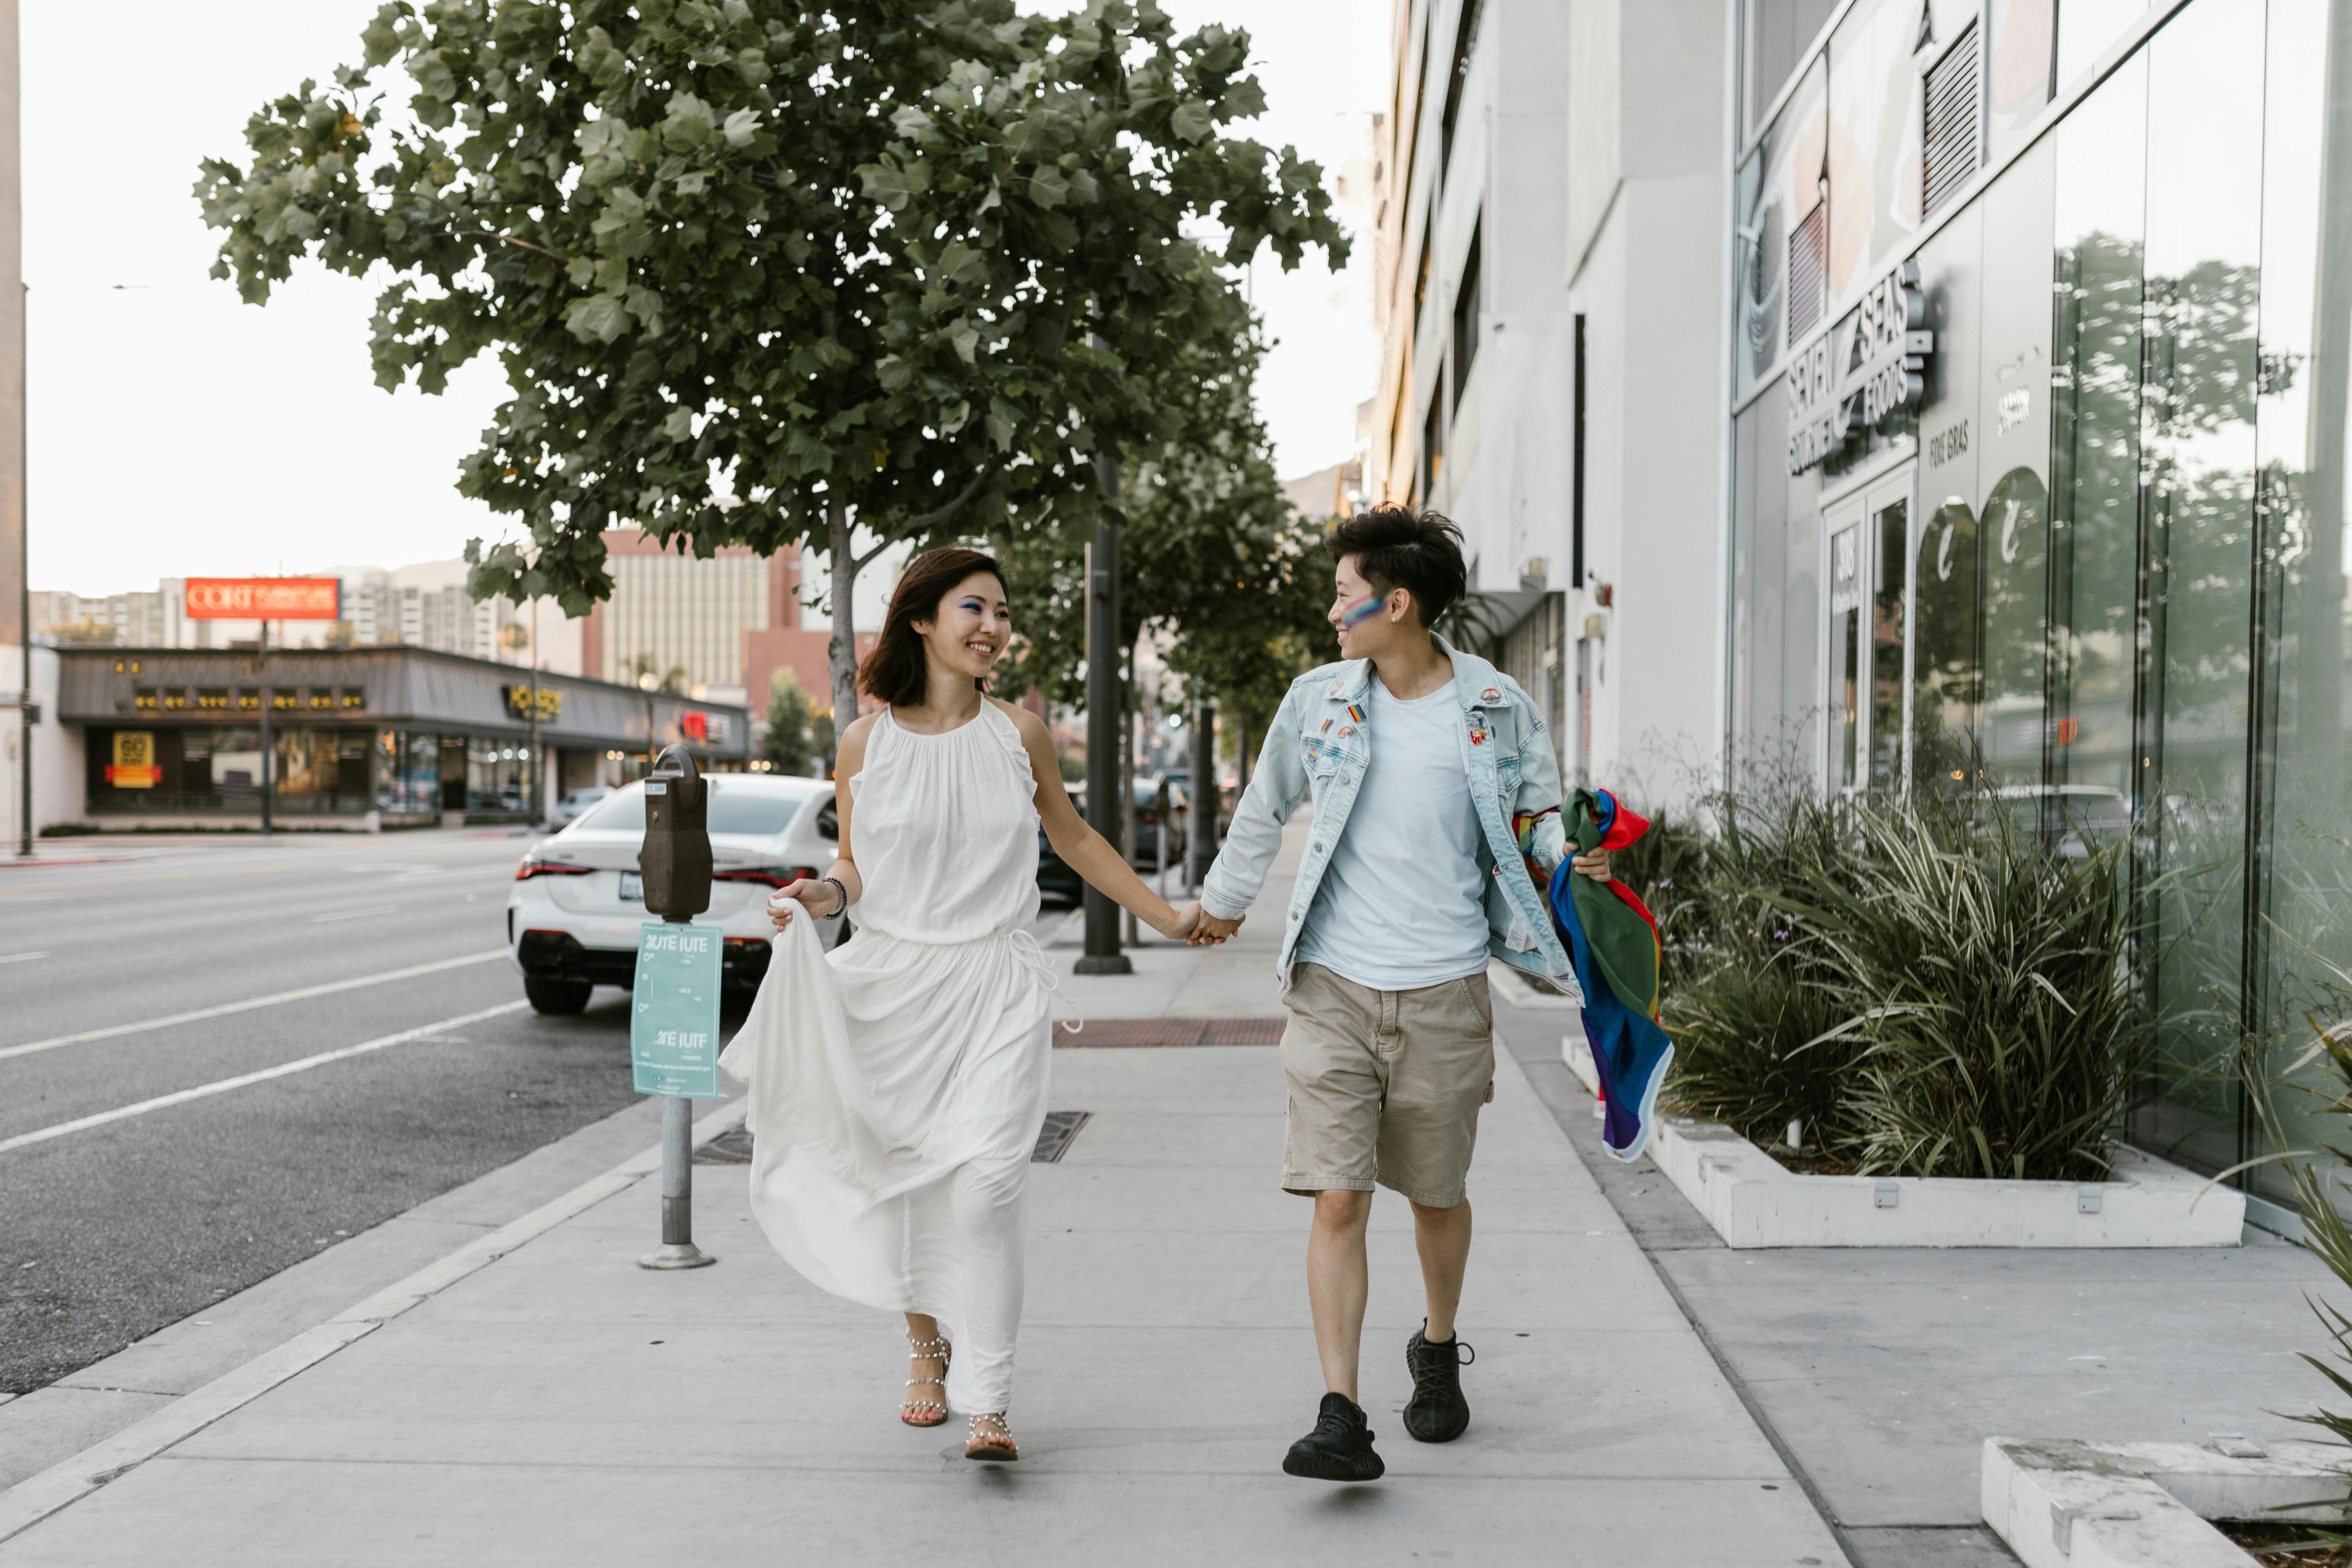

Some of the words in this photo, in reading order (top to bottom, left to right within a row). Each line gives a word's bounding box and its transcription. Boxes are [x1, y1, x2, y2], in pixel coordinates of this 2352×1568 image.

[1789, 329, 1833, 420] SEVEN
[1859, 261, 1908, 365] SEAS
[1863, 355, 1908, 426] FOODS
[1948, 418, 1968, 462] GRAS
[1838, 527, 1854, 582] 318
